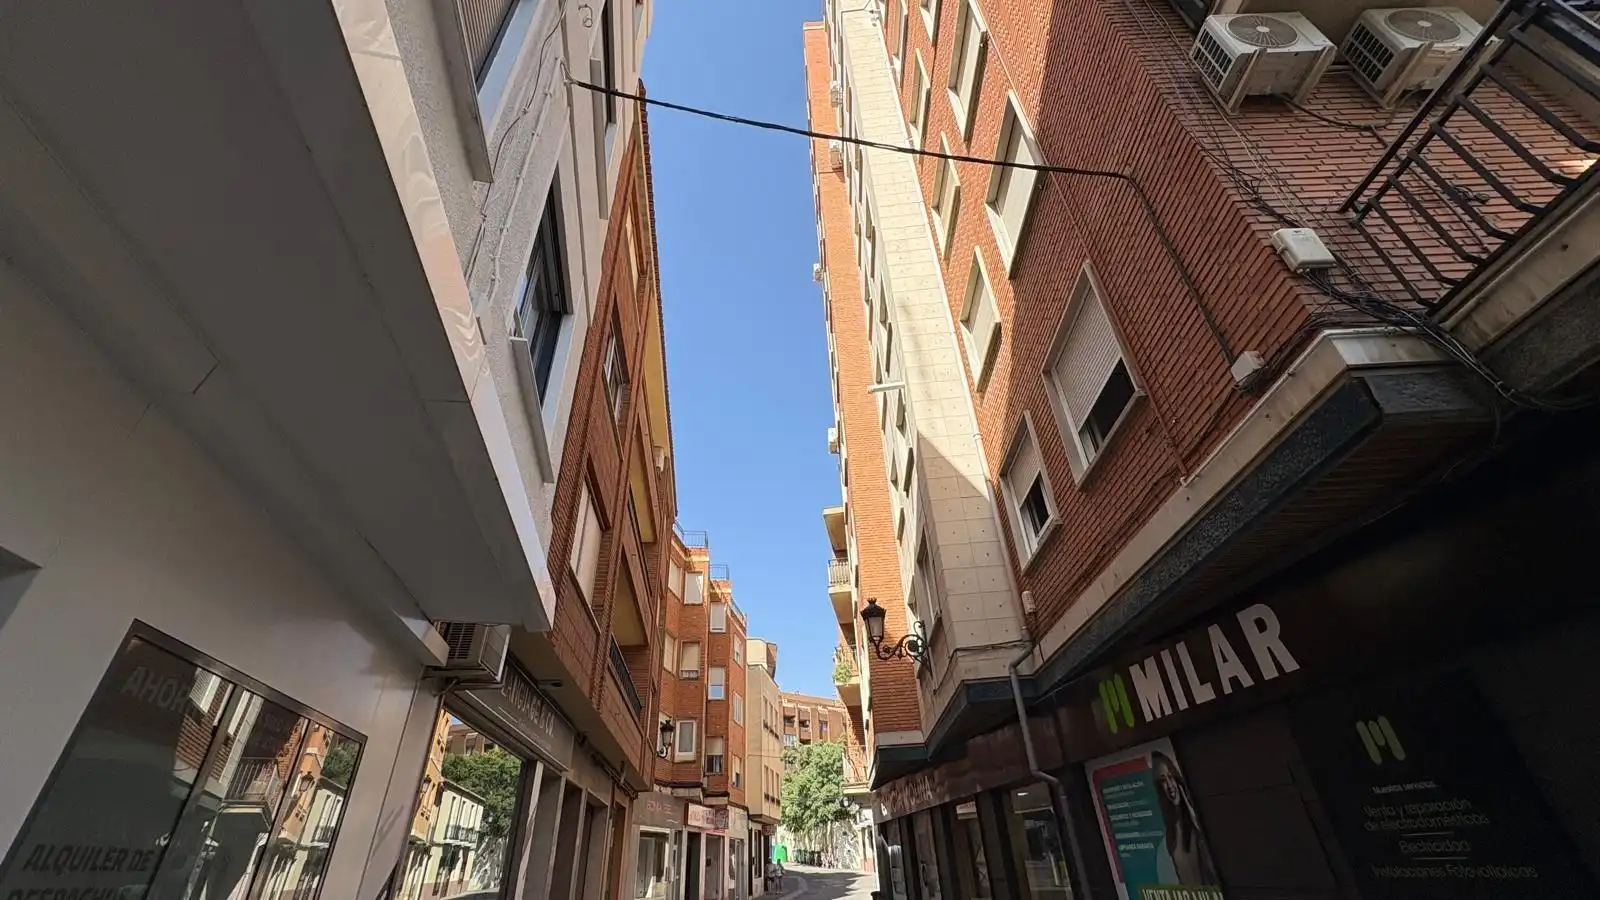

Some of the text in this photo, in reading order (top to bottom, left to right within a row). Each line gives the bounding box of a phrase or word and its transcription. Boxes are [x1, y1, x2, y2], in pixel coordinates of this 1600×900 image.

[1129, 604, 1300, 722] MILAR
[1362, 804, 1395, 819] Venta
[23, 843, 128, 874] ALQUILER
